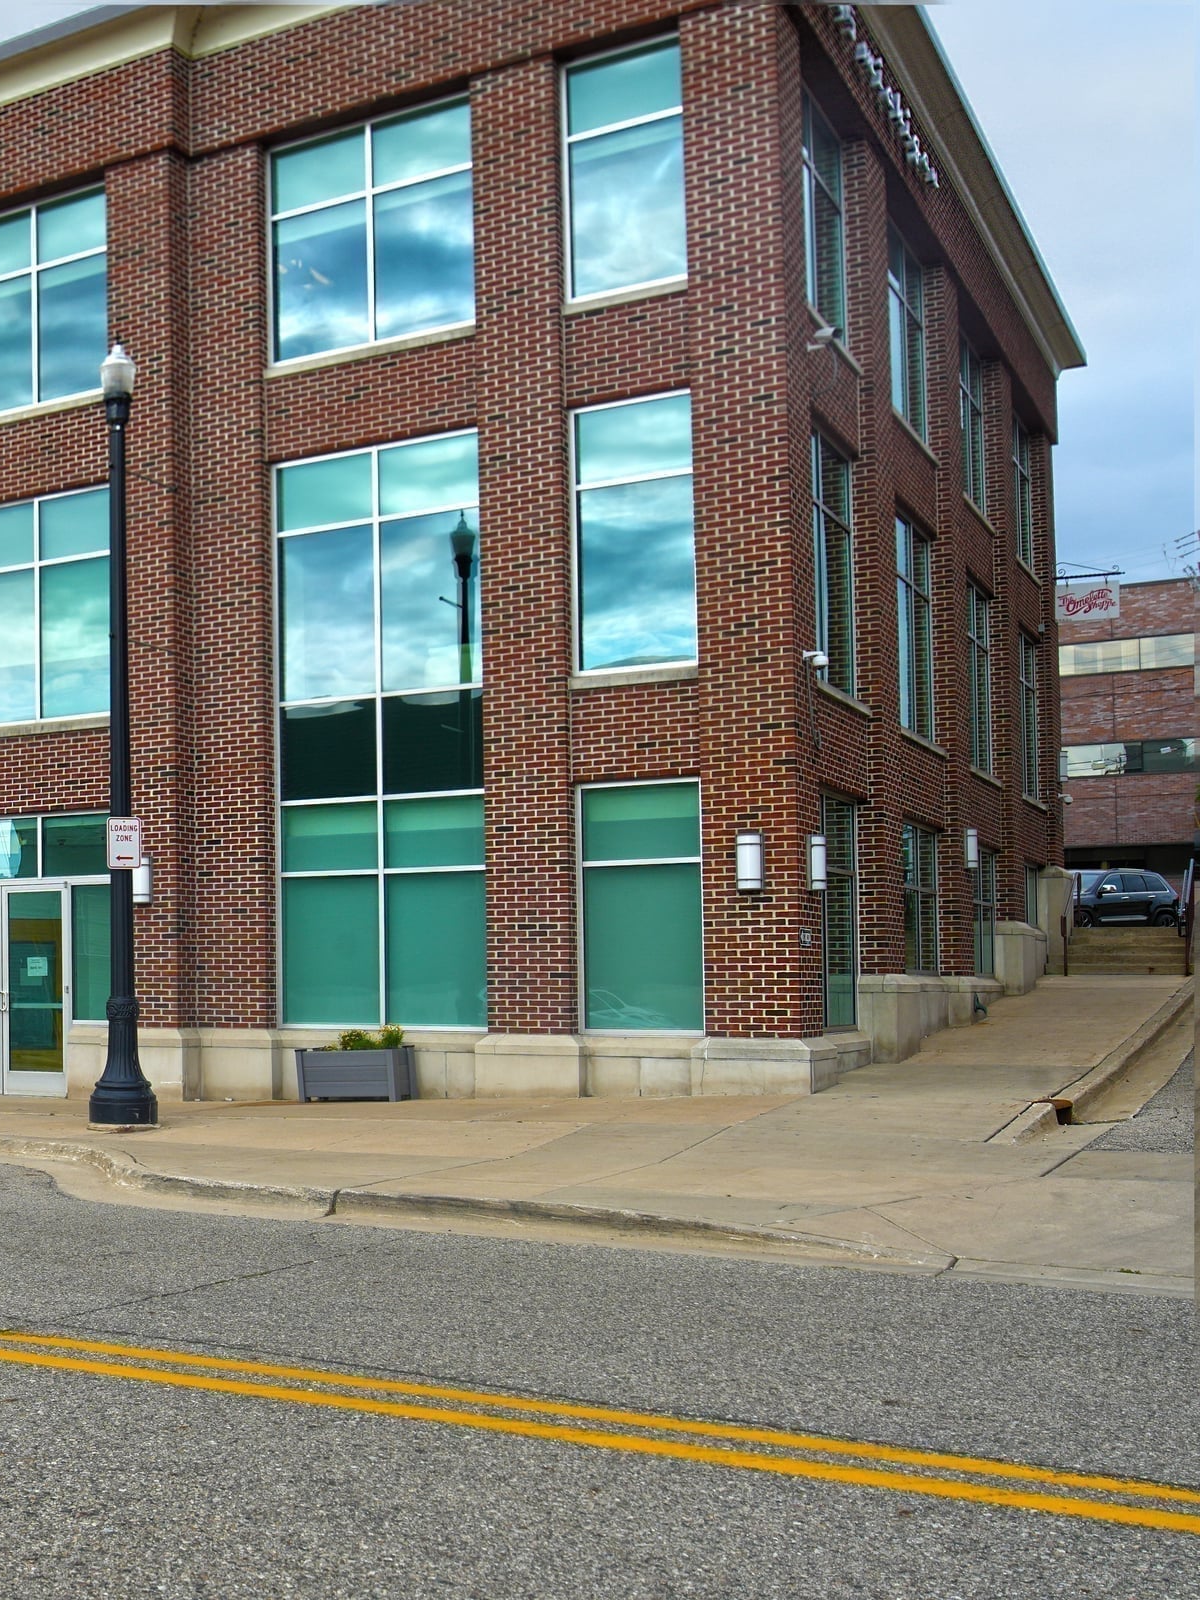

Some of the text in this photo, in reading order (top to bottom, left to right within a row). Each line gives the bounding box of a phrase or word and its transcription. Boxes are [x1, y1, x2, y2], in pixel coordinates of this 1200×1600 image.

[1064, 589, 1112, 615] Omelette
[1083, 598, 1117, 614] Shoppe
[110, 824, 138, 832] LOADING
[115, 834, 133, 842] ZONE
